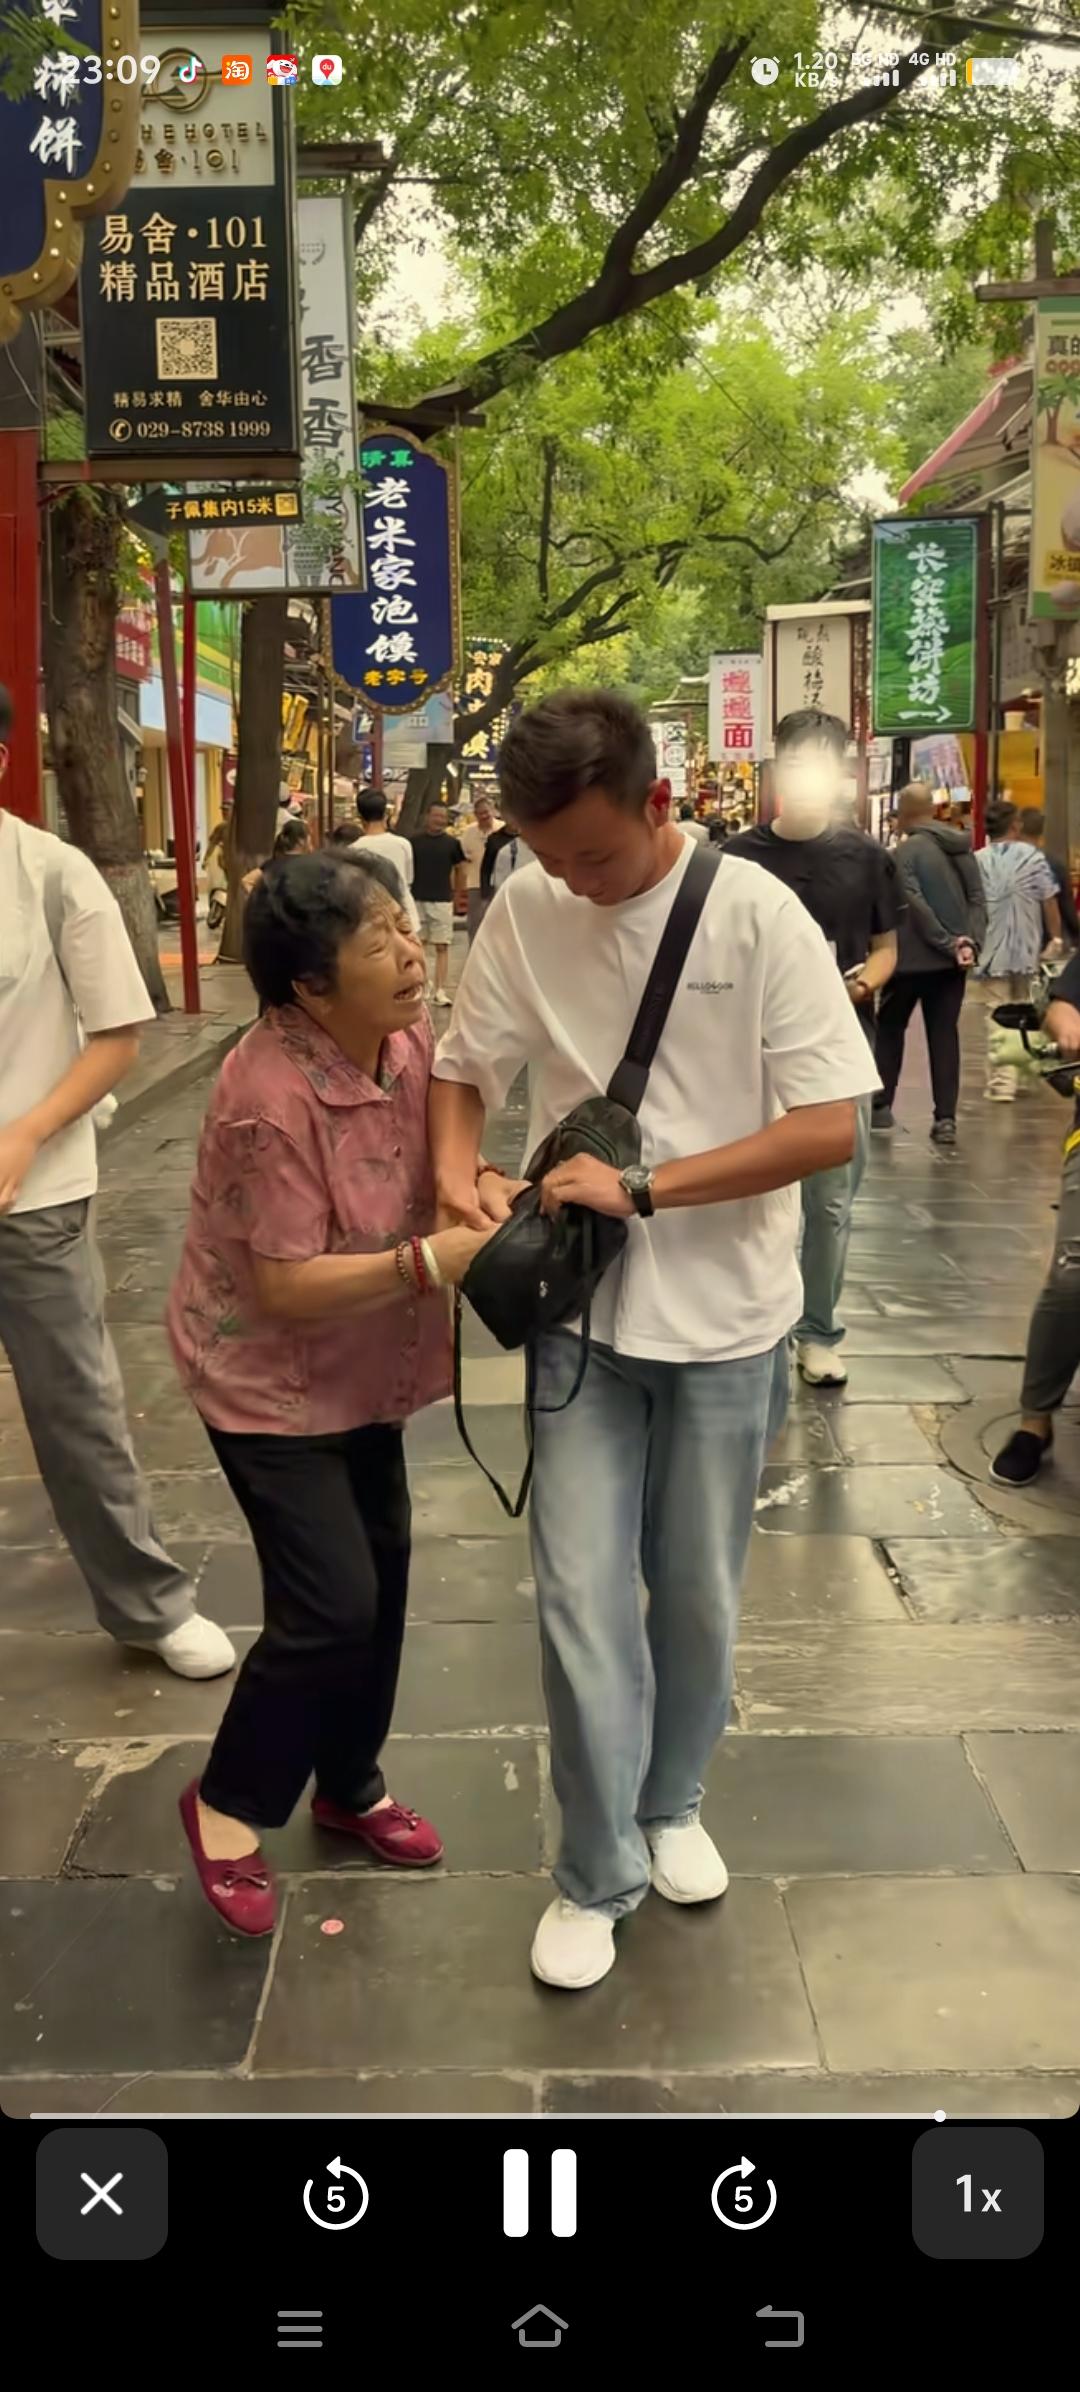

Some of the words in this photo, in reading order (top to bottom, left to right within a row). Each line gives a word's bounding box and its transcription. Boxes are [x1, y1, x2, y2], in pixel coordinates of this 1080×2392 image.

[98, 211, 268, 255] 易舍·101
[99, 259, 270, 303] 精品酒店
[300, 284, 349, 448] 香香
[113, 390, 183, 409] 精易求精
[364, 476, 419, 664] 老米家泡馍
[363, 668, 429, 686] 老字号
